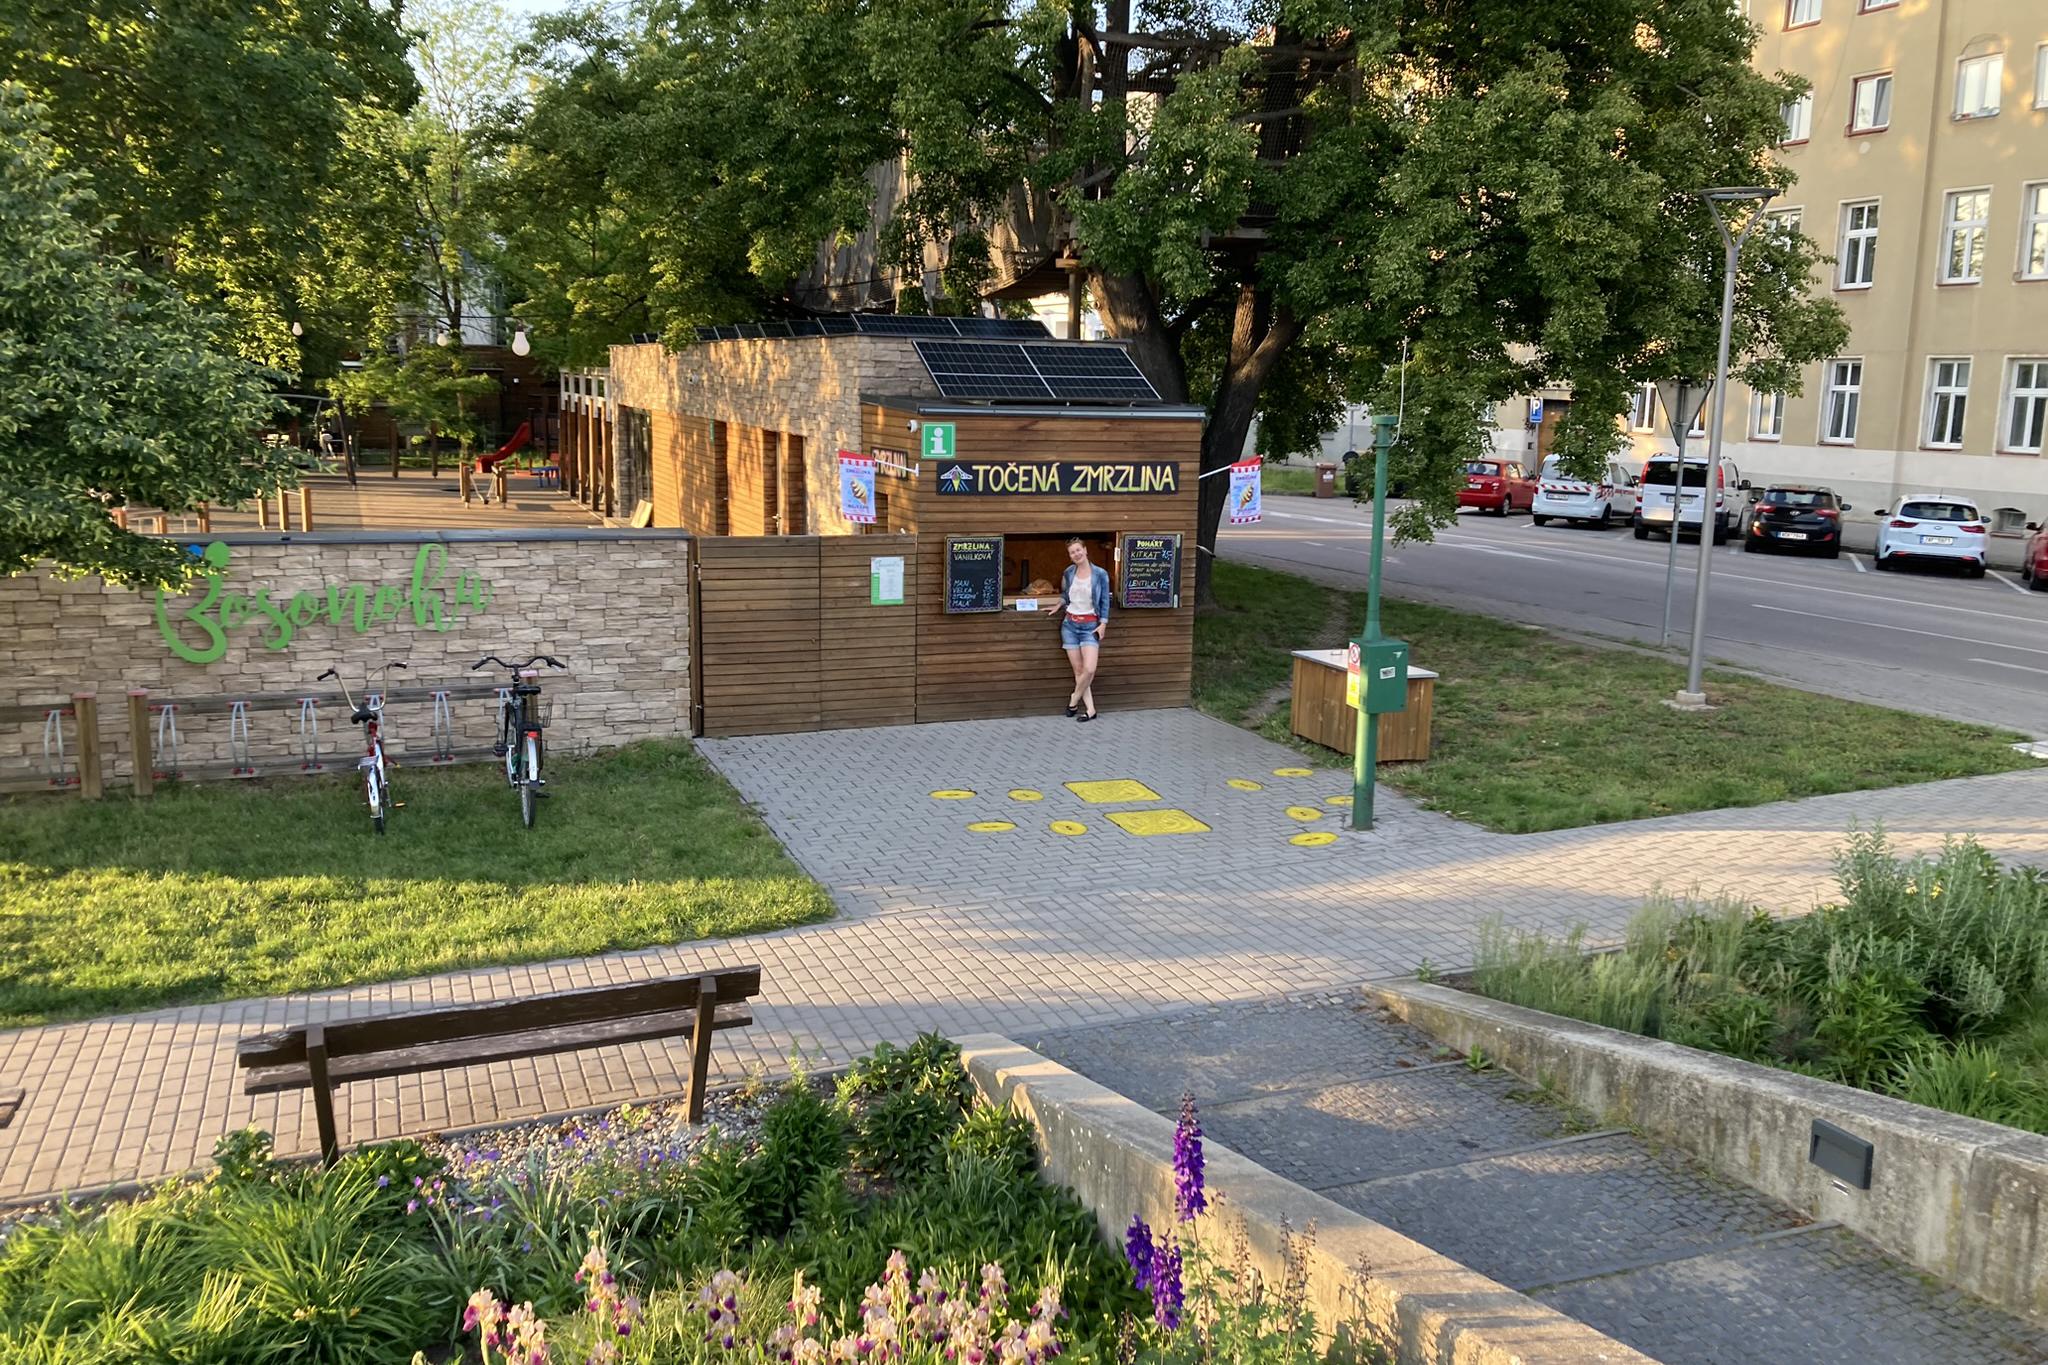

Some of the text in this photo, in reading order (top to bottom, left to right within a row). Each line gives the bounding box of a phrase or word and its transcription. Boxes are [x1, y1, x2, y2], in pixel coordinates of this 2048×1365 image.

[1533, 400, 1540, 414] P
[972, 462, 1176, 493] TOČENÁ ZMRZLINA
[1130, 550, 1160, 558] KITKAT
